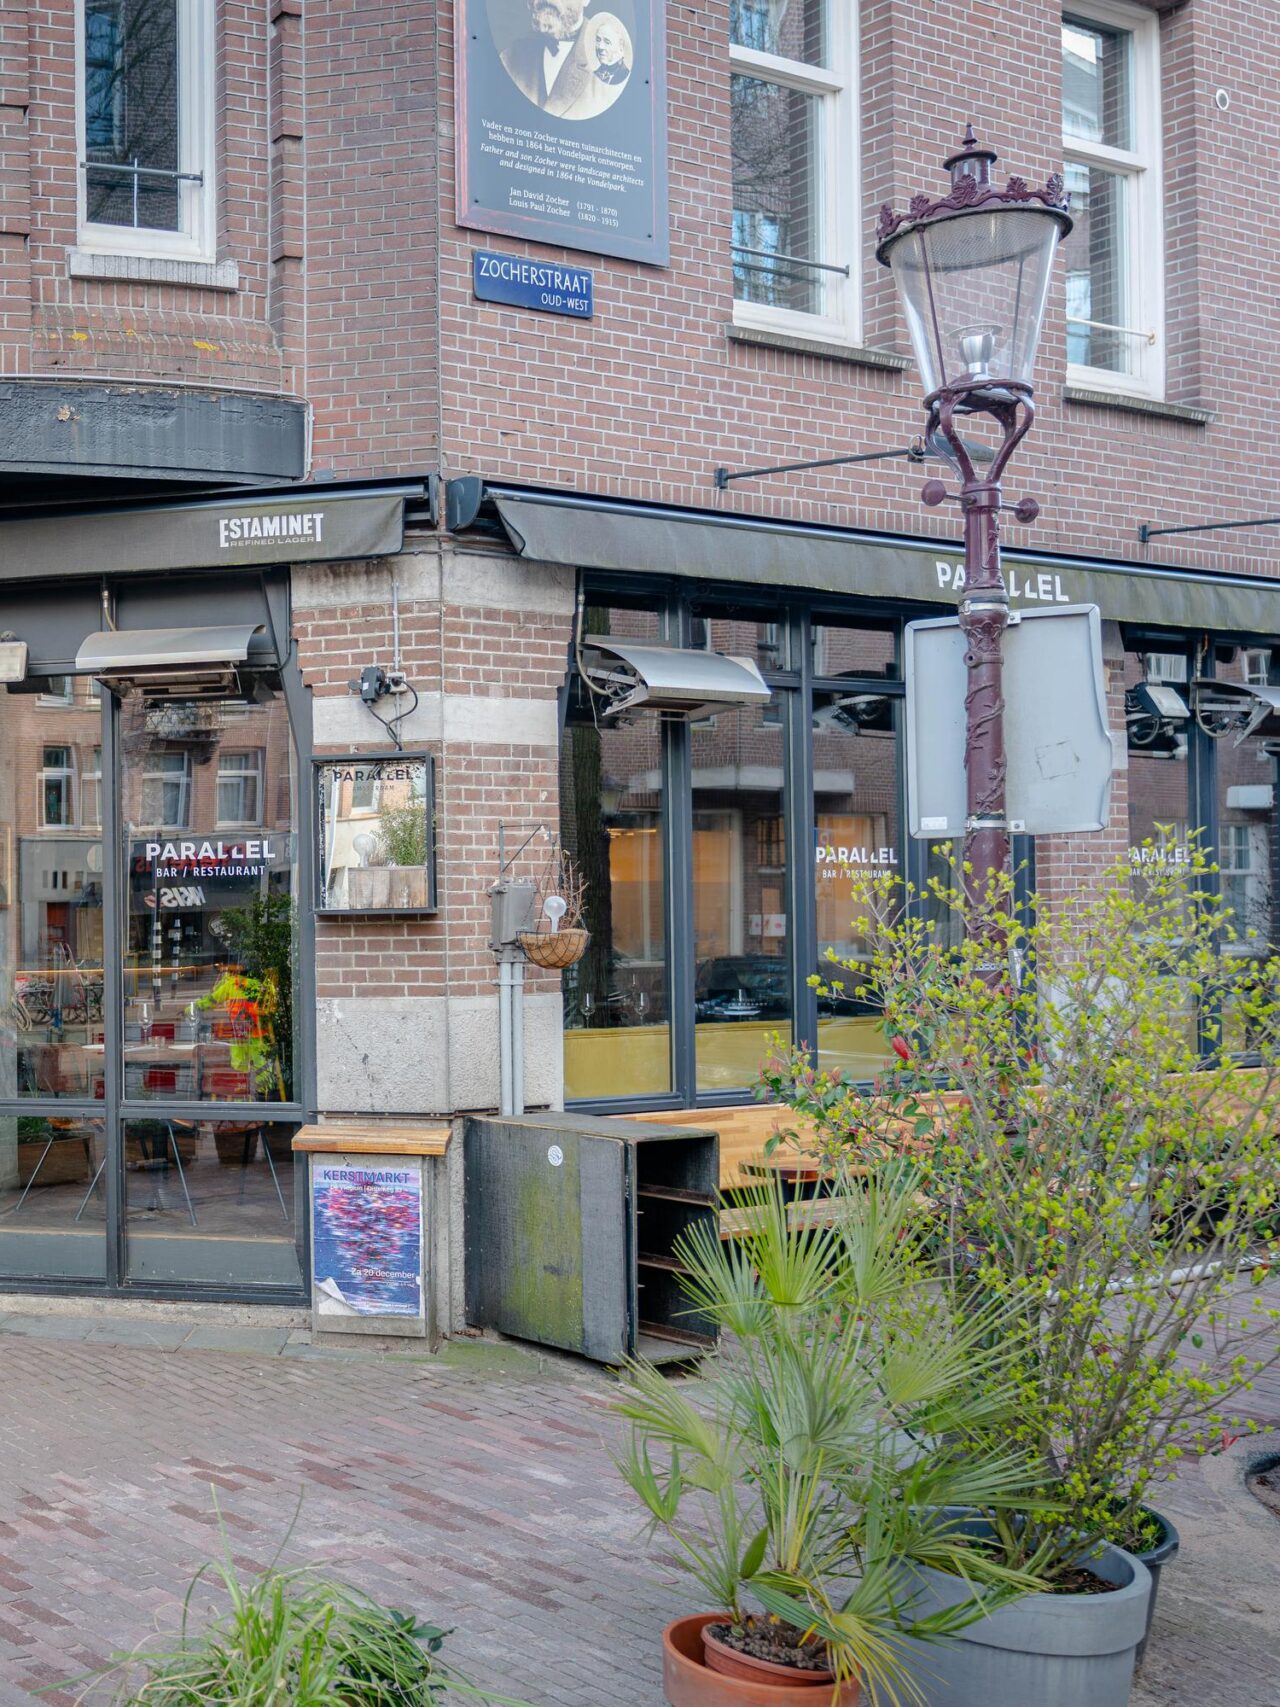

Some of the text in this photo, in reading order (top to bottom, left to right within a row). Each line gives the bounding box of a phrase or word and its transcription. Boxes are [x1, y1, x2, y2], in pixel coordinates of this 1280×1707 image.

[481, 119, 642, 163] Vader en zoon Zocher waren tuinarchitecten en
[488, 130, 636, 171] hebben in 1864 het Vondelpark ontworpen.
[480, 143, 644, 186] Father and son Zocher were landscape architects
[499, 159, 627, 192] and designed in 1864 the Vondelpark.
[508, 197, 528, 208] Louis
[529, 201, 545, 212] Paul
[546, 205, 571, 217] Zocher
[578, 211, 596, 223] (1820
[601, 217, 619, 228] 1915)
[509, 186, 522, 197] Jan
[523, 189, 544, 201] David
[545, 193, 570, 206] Zocher
[576, 200, 595, 212] (1791
[600, 206, 618, 217] 1870)
[480, 257, 589, 294] ZOCHERSTRAAT
[541, 293, 589, 312] OUD-WEST
[219, 512, 324, 547] ESTAMINET
[230, 536, 315, 547] REFINED LAGER
[935, 561, 1070, 602] PALLEL
[333, 769, 414, 782] PARALLEL
[145, 840, 276, 861] PARALLEL
[815, 846, 898, 864] PARALLEL
[156, 867, 178, 877] BAR
[193, 865, 265, 877] RESTAURANT
[822, 869, 837, 878] BAR
[323, 1170, 410, 1183] KERSTMARKT
[351, 1267, 415, 1279] Za 20 december
